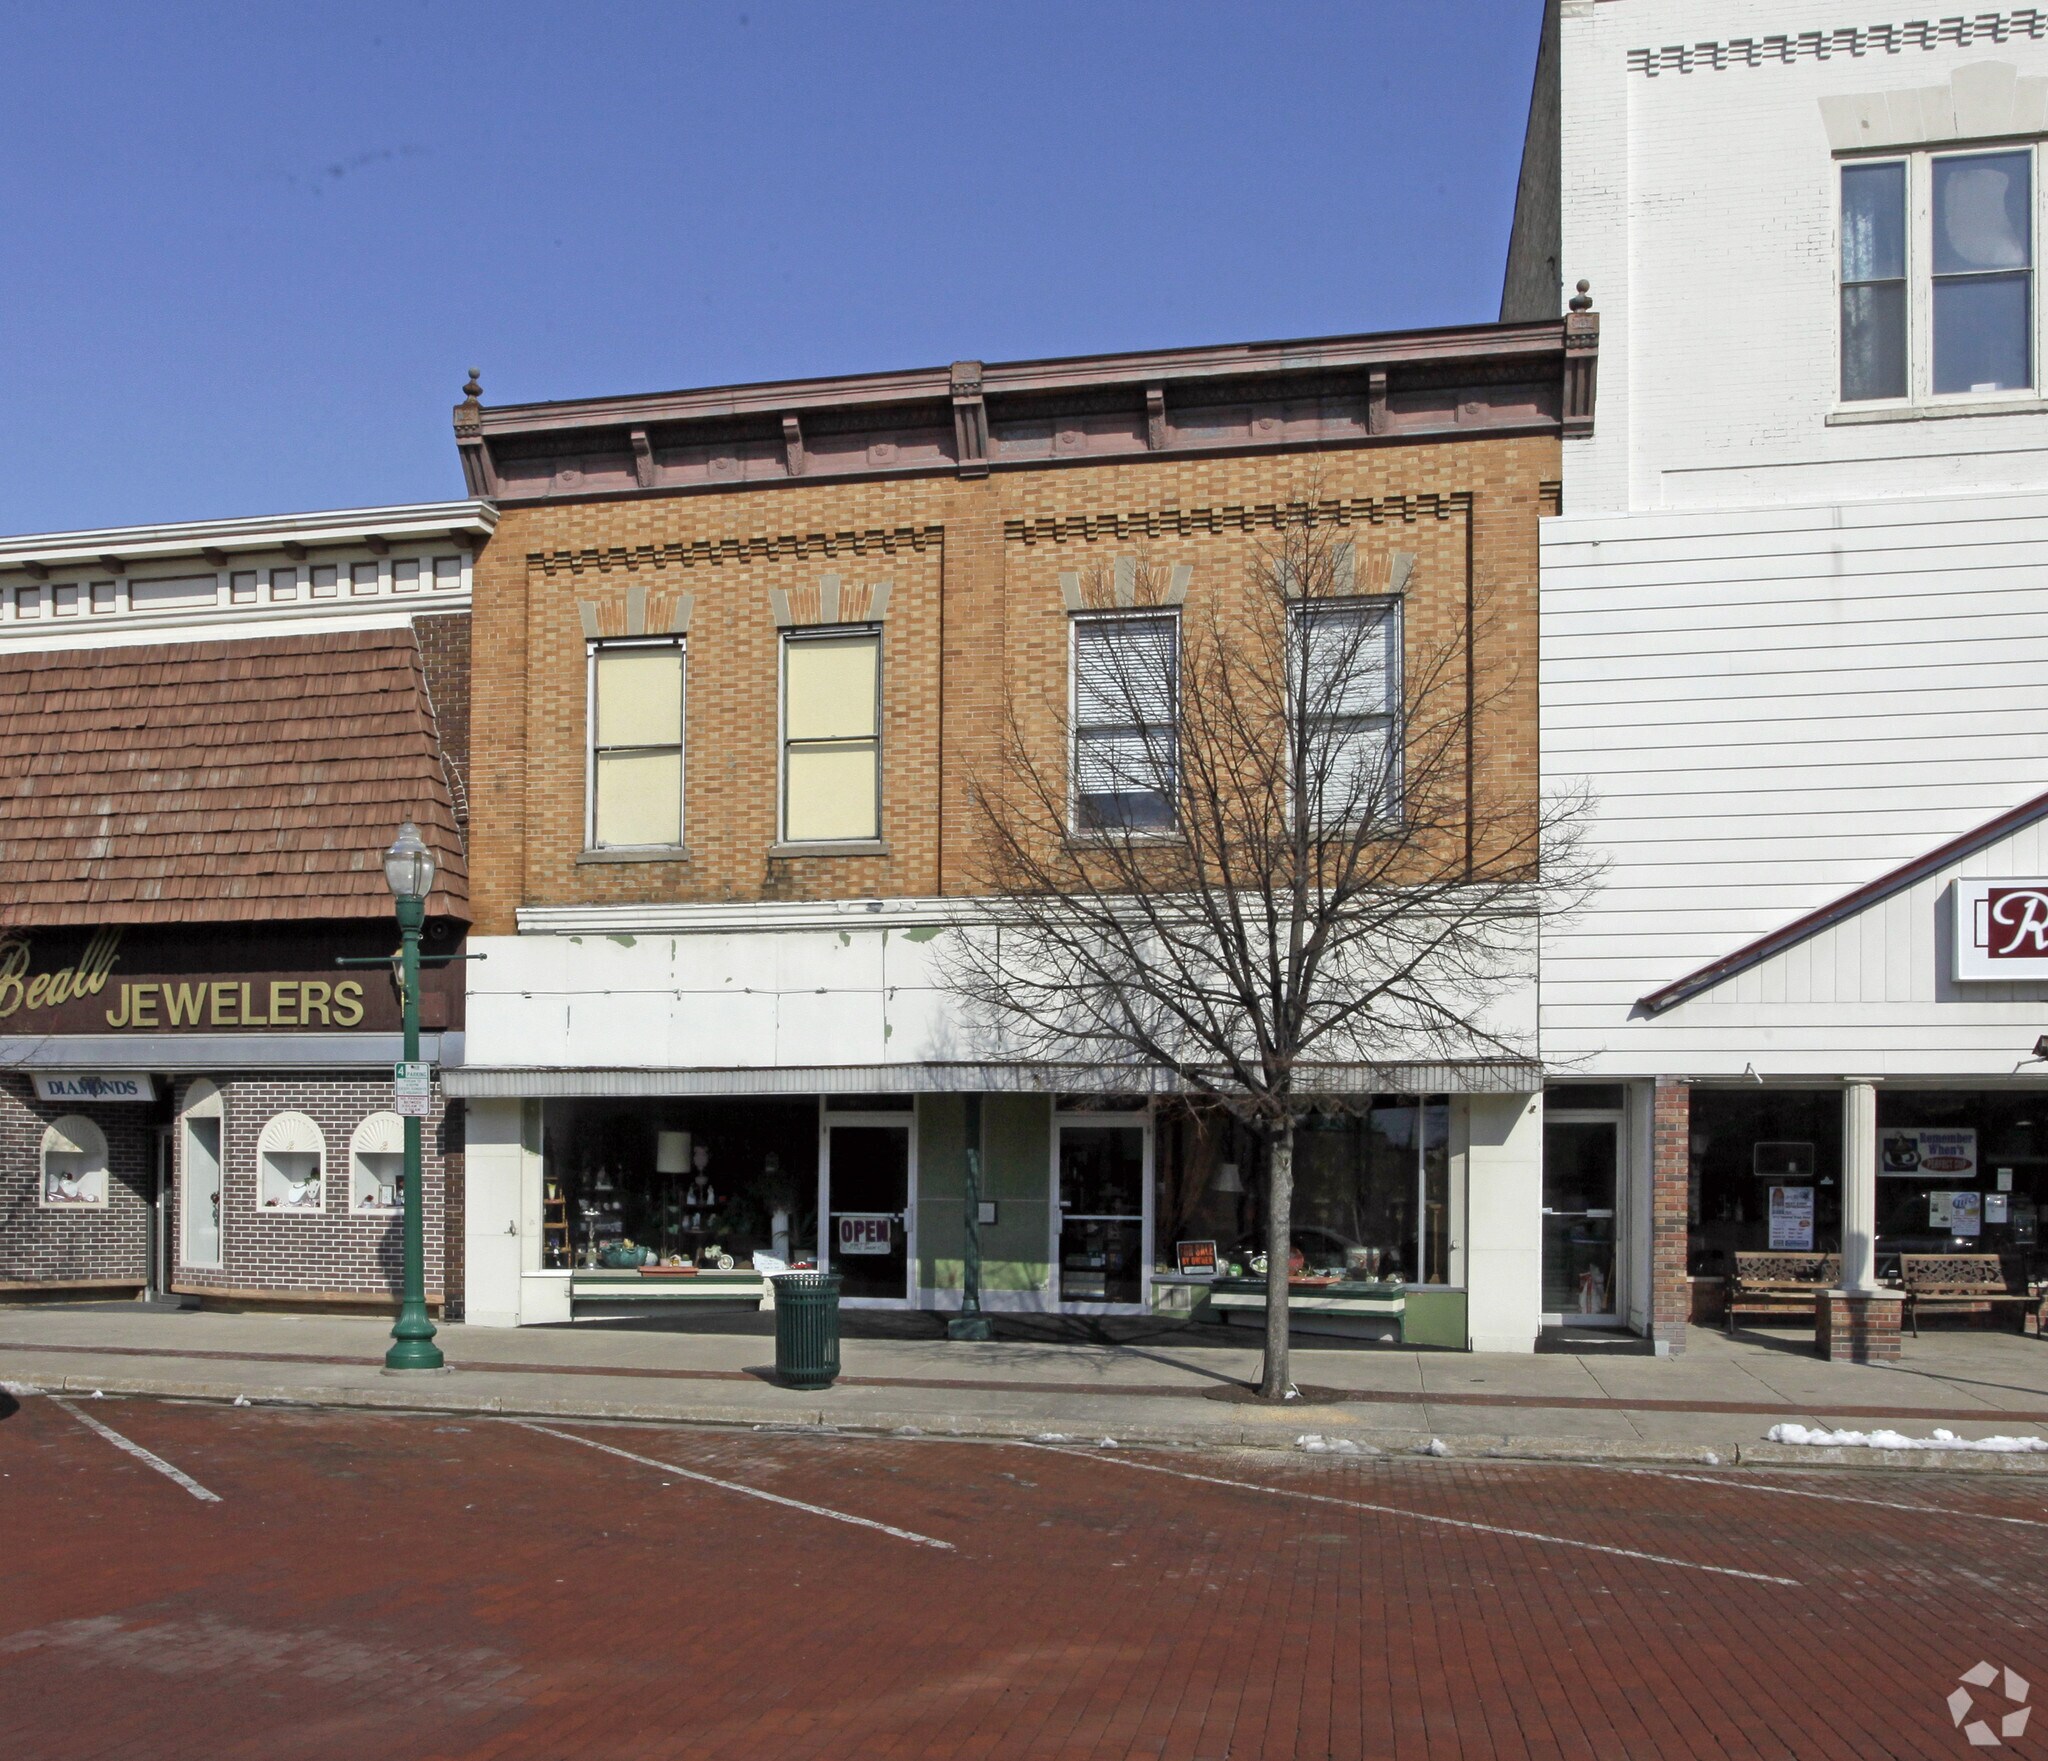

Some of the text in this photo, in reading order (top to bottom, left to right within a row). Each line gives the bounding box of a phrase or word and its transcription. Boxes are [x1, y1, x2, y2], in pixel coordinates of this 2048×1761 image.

[0, 929, 123, 1018] Beall
[106, 981, 365, 1028] JEWELERS
[398, 1066, 404, 1076] 4
[48, 1080, 138, 1096] DIAMONDS
[1919, 1132, 1973, 1144] Remember
[1928, 1143, 1965, 1155] When's
[841, 1220, 889, 1243] OPEN
[1195, 1244, 1214, 1256] SALE
[1182, 1256, 1213, 1265] BY OWNER
